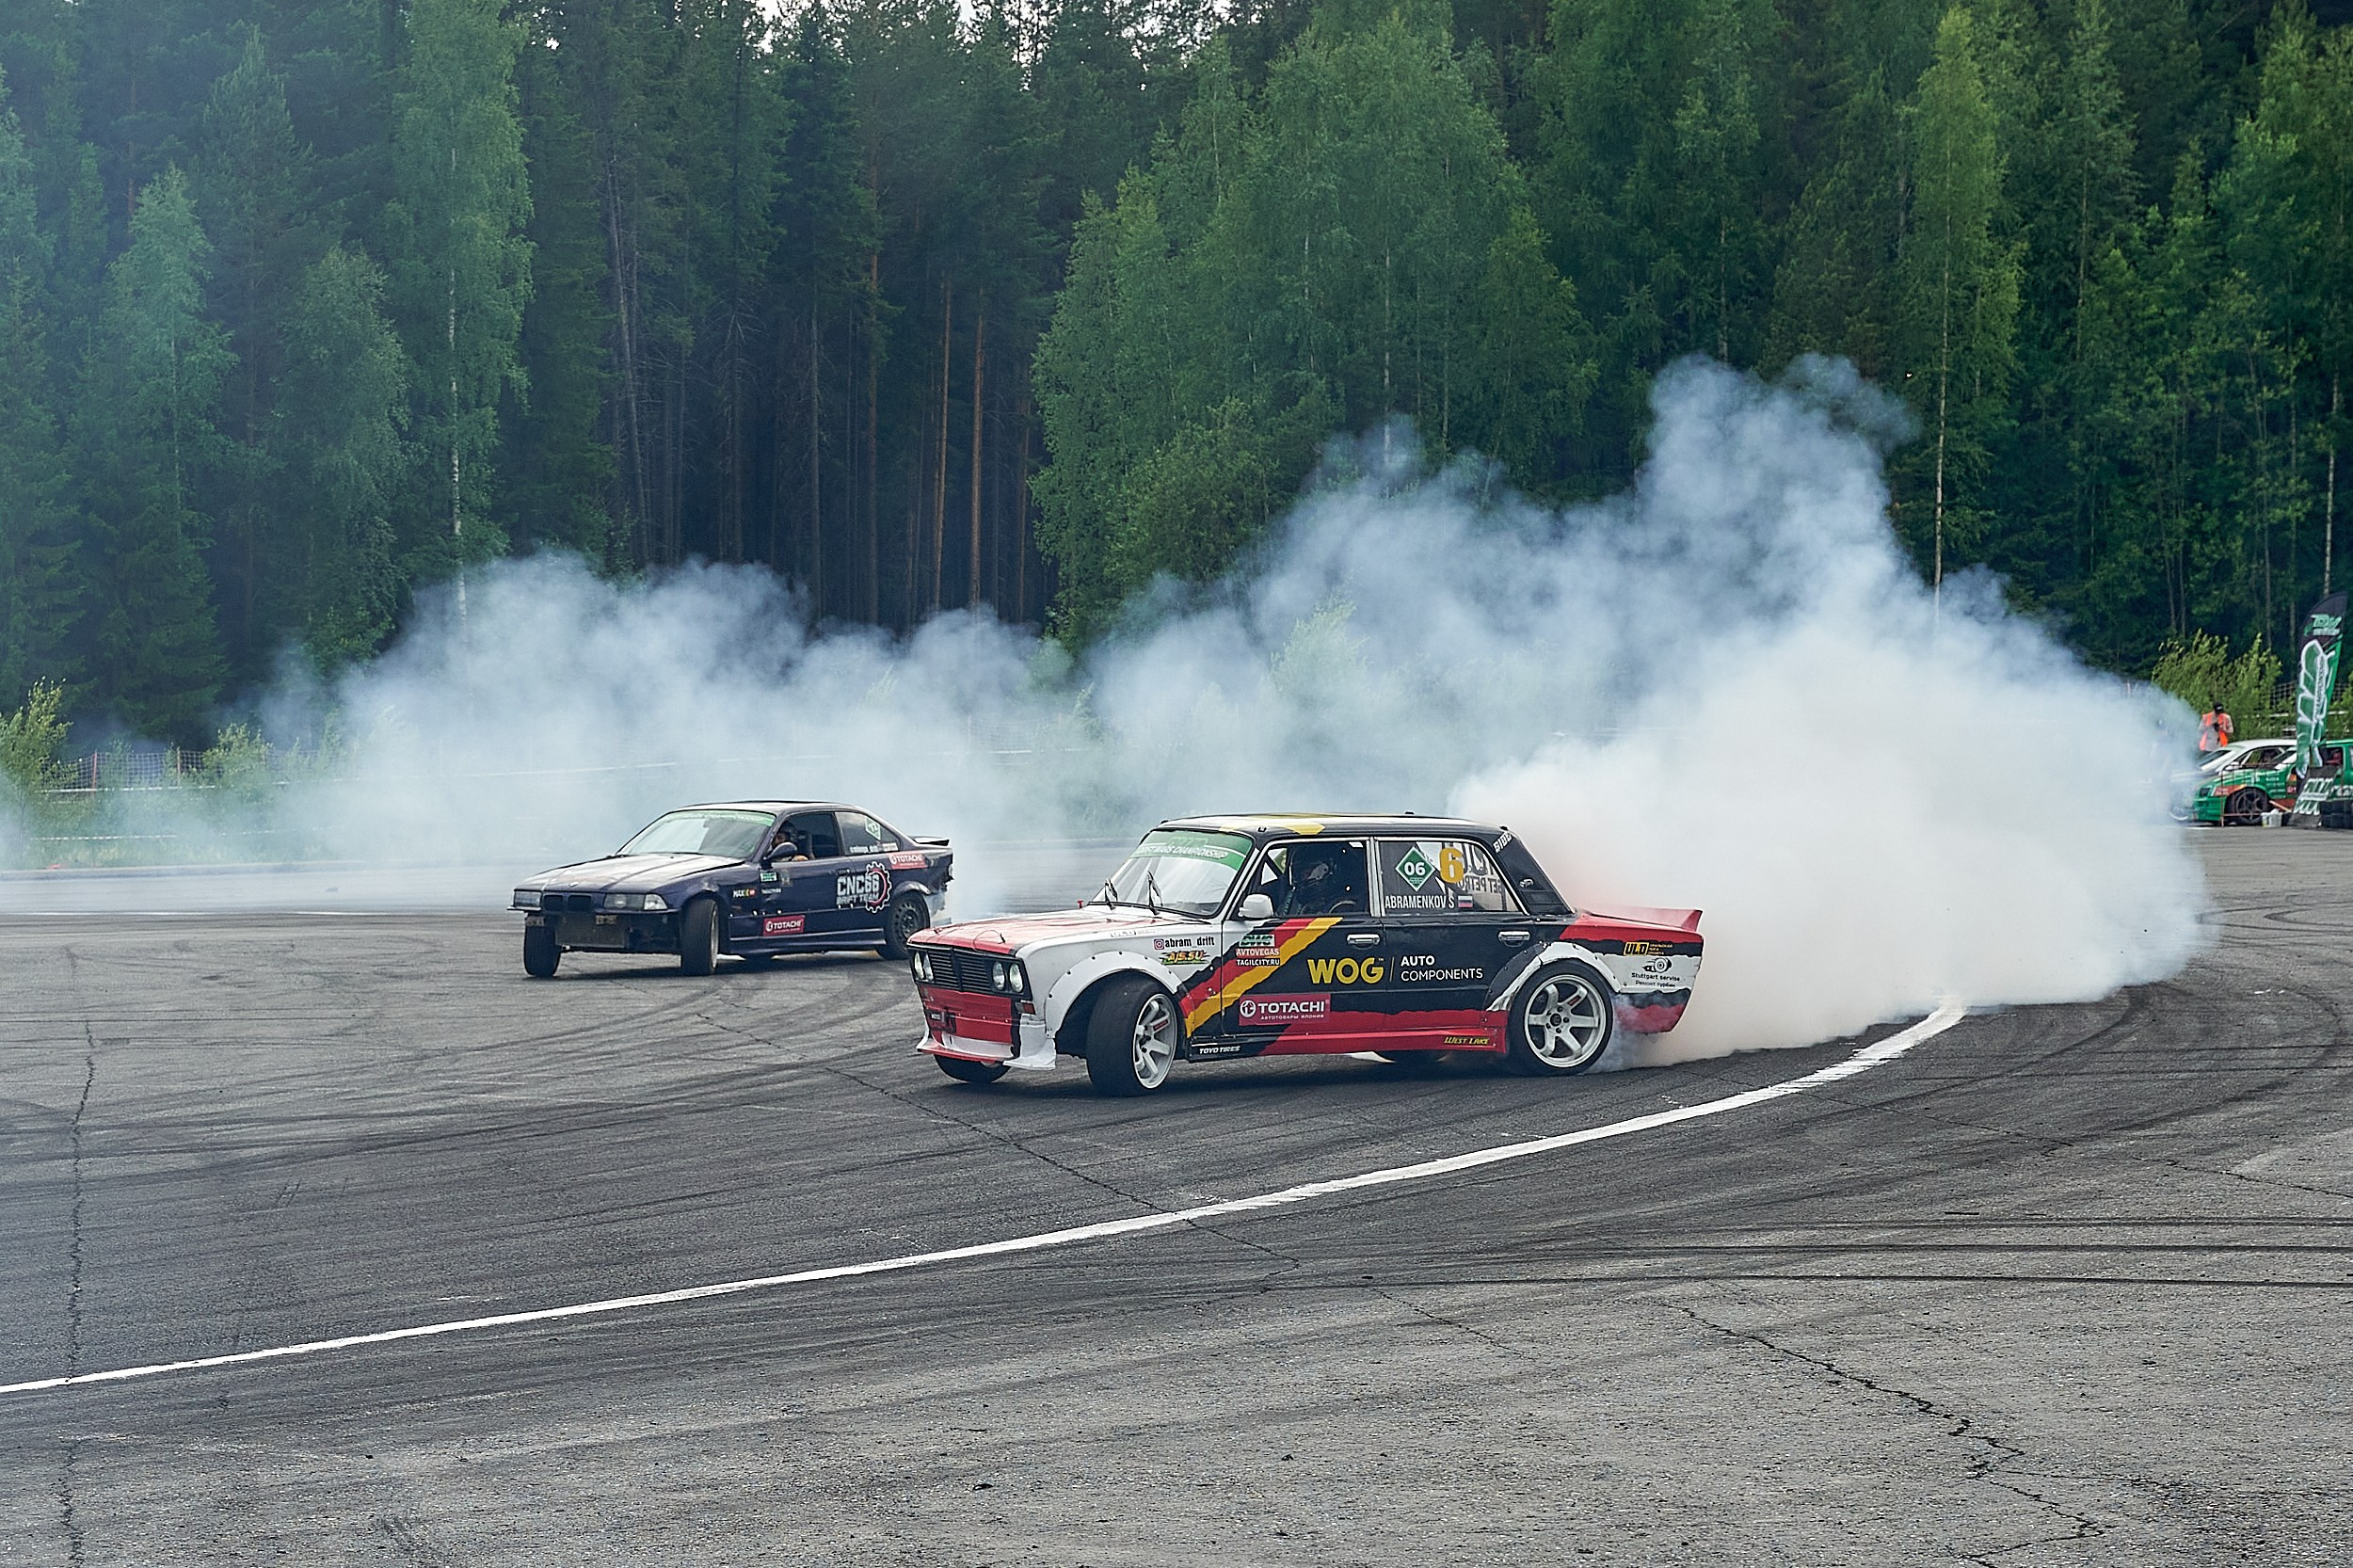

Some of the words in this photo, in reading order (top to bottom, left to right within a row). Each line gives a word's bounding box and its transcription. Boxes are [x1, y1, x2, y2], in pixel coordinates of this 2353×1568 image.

[1403, 861, 1426, 876] 06
[1439, 847, 1465, 884] 6
[837, 873, 880, 896] CNC66
[1385, 895, 1447, 909] ABRAMENKOV
[1449, 896, 1455, 909] S
[774, 920, 802, 929] TOTACHI
[1164, 936, 1215, 949] abram_drift
[1235, 948, 1280, 956] AVTOVEGAS
[1236, 958, 1280, 967] TAGILCITY.RU
[1401, 954, 1435, 968] AUTO
[1307, 957, 1385, 984] WOG
[1401, 968, 1483, 982] COMPONENTS
[1631, 972, 1658, 981] Stuttgart
[1257, 1000, 1325, 1014] TOTACHI
